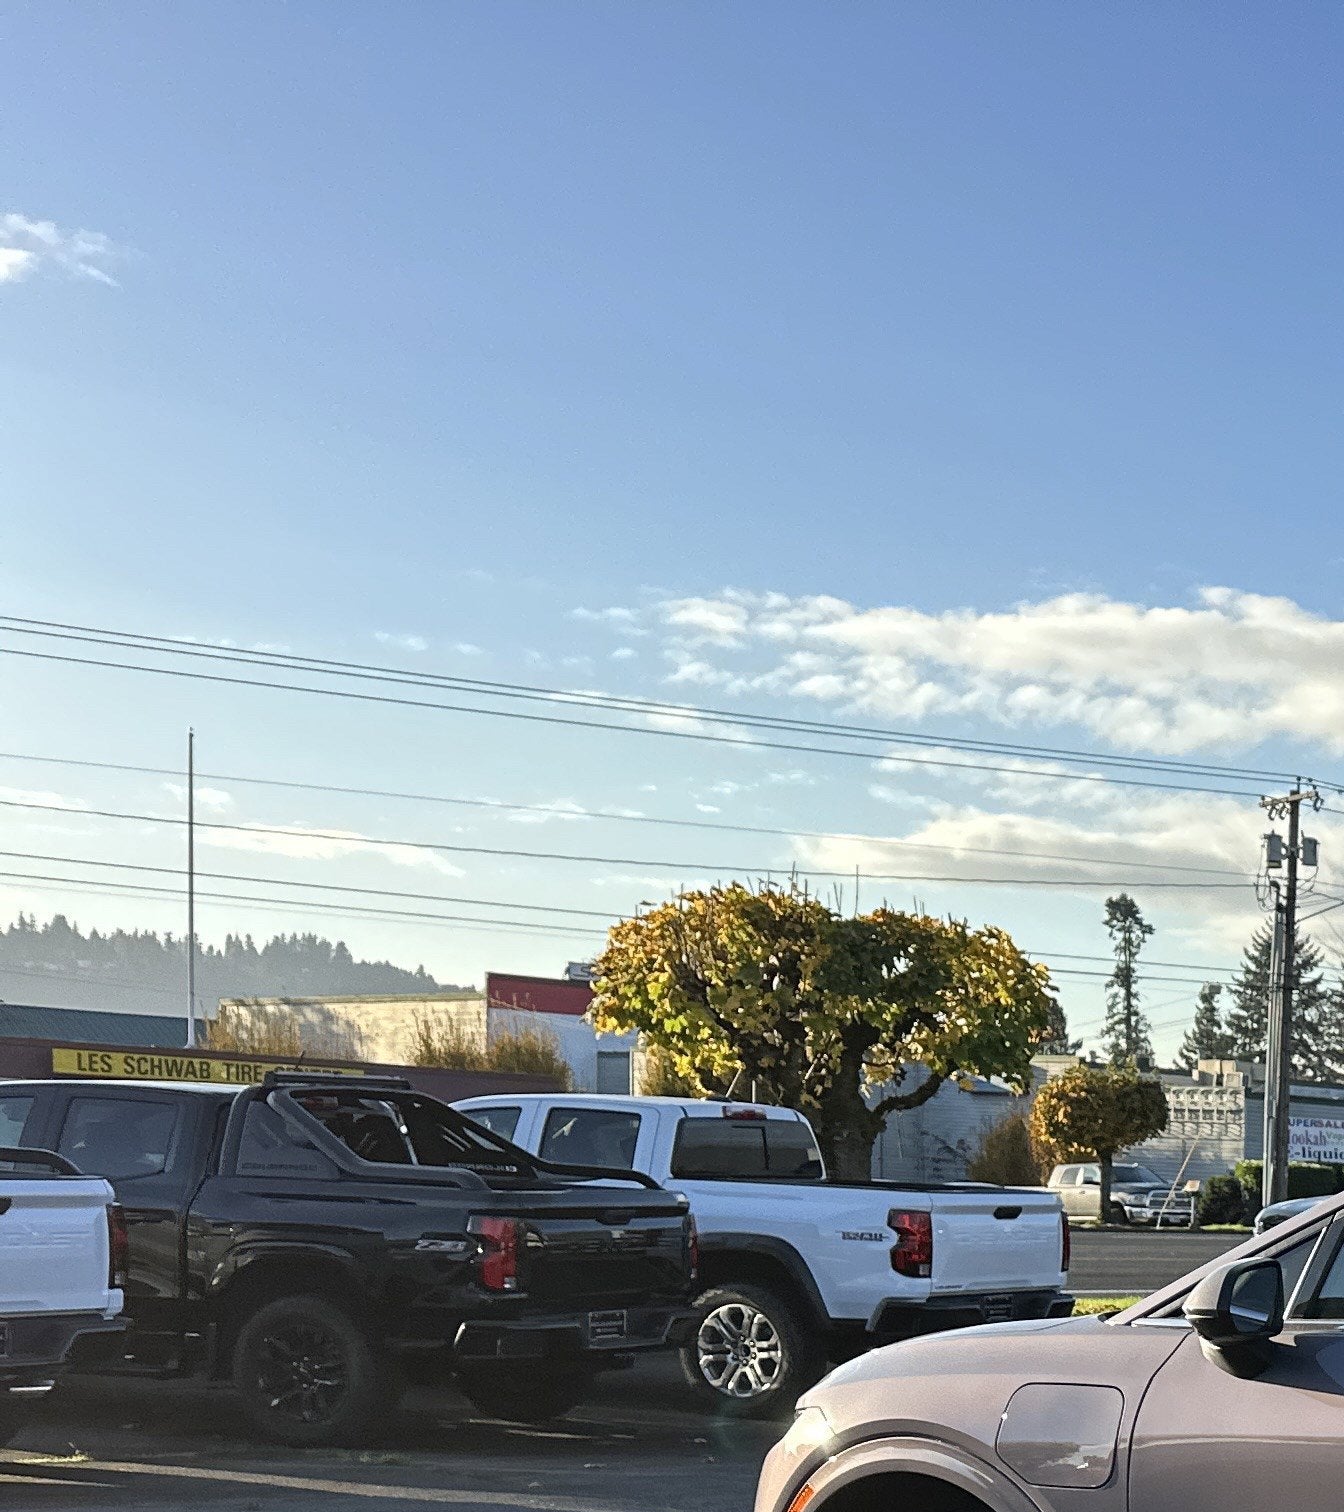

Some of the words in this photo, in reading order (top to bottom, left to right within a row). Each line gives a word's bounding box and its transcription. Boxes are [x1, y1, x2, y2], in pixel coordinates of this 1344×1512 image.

[76, 1051, 113, 1074] LES
[123, 1054, 212, 1080] SCHWAB
[220, 1061, 264, 1084] TIRE
[1288, 1130, 1327, 1146] ookah
